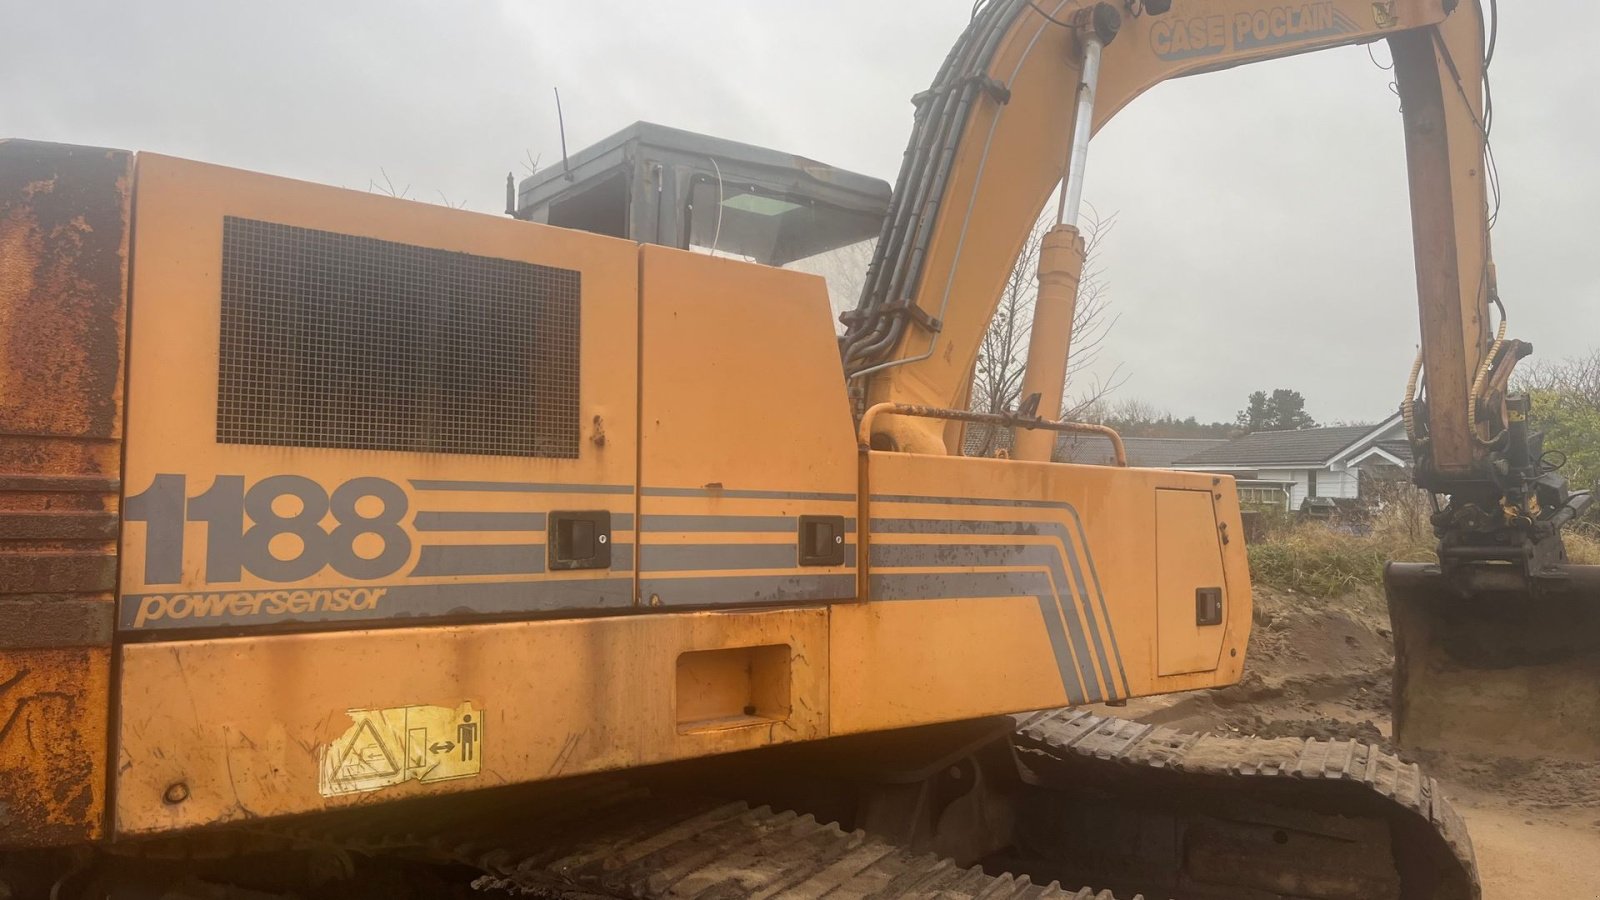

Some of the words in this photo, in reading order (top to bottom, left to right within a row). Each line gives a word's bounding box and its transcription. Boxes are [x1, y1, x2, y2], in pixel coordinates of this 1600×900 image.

[1151, 17, 1226, 57] CASE
[1234, 2, 1335, 46] POCLAIN
[125, 473, 412, 585] 1188
[132, 587, 388, 629] powersensor
